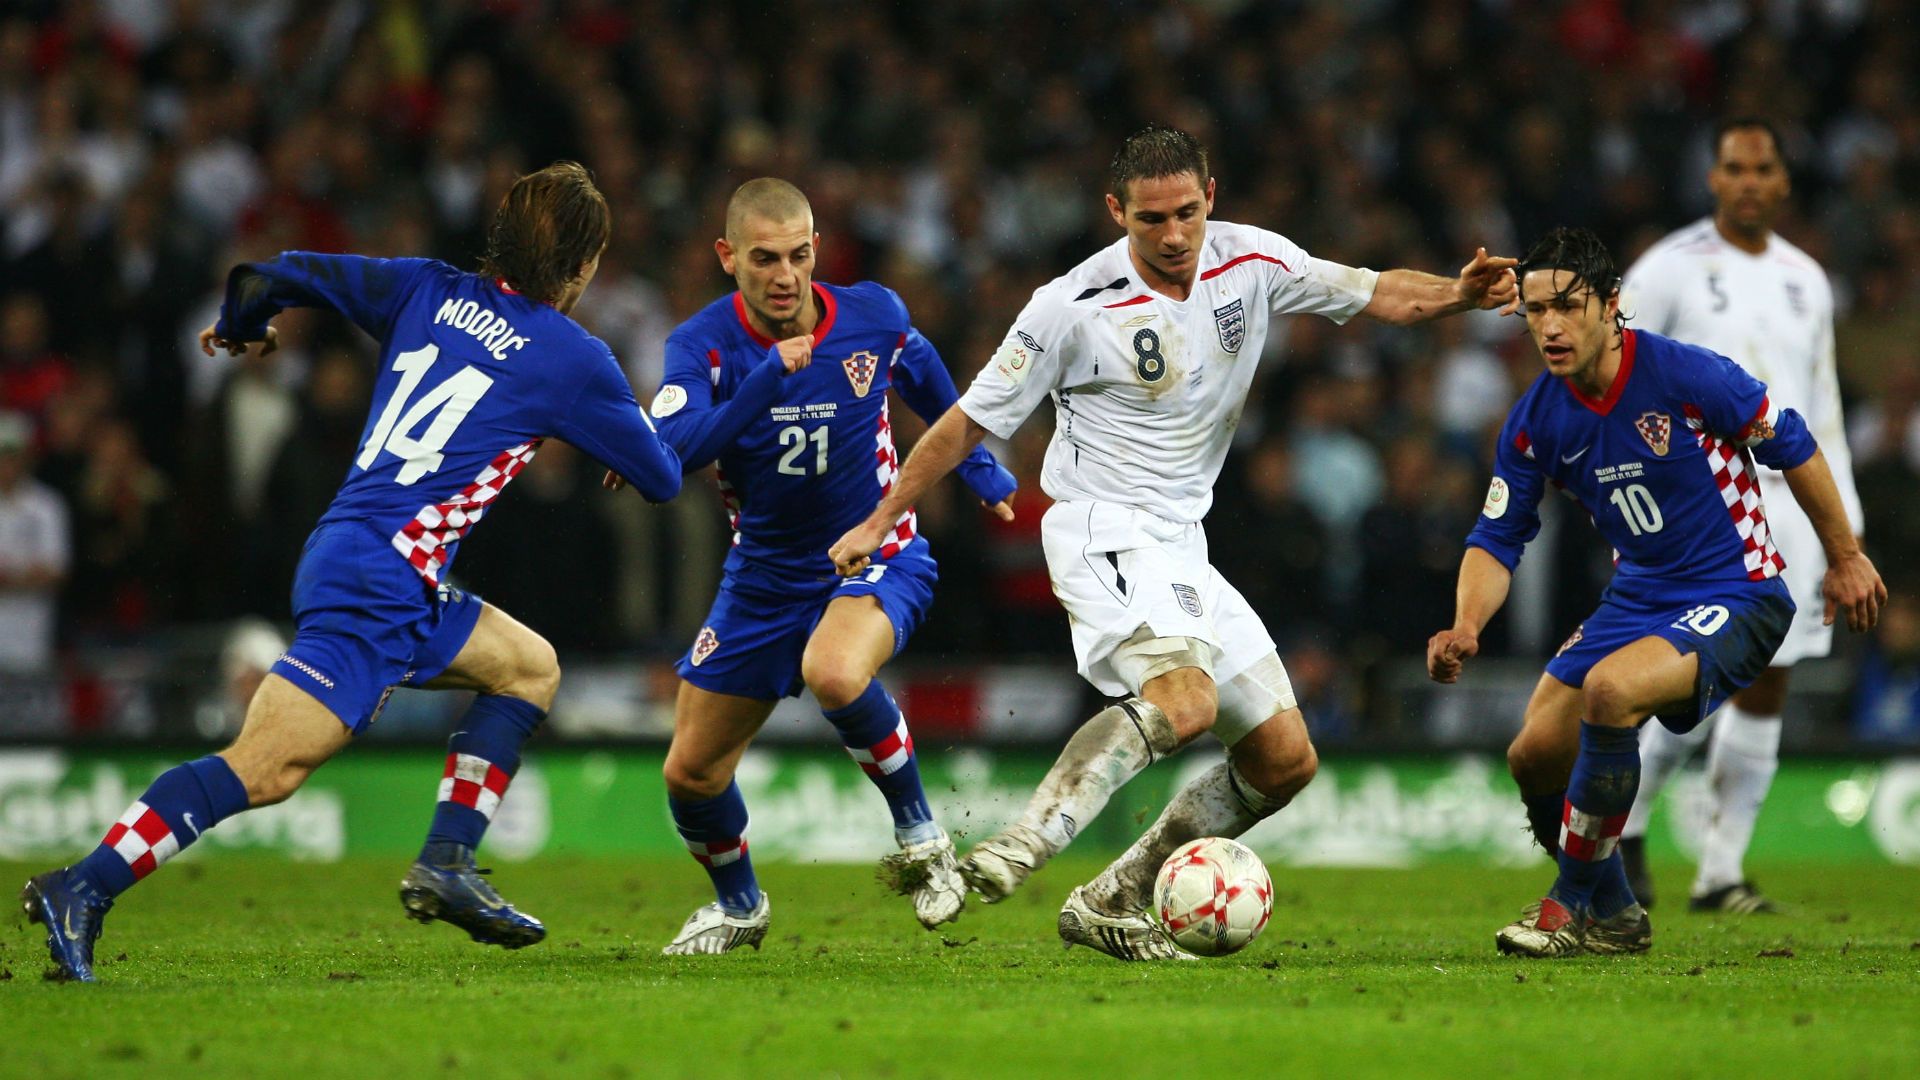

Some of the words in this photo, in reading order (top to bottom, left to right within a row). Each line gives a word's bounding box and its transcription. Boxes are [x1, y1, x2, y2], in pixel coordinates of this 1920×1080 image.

[1215, 300, 1241, 316] ENGLAND
[1707, 272, 1728, 313] 5
[1133, 328, 1167, 383] 8
[356, 343, 494, 486] 14
[778, 425, 829, 475] 21
[1610, 484, 1664, 536] 10
